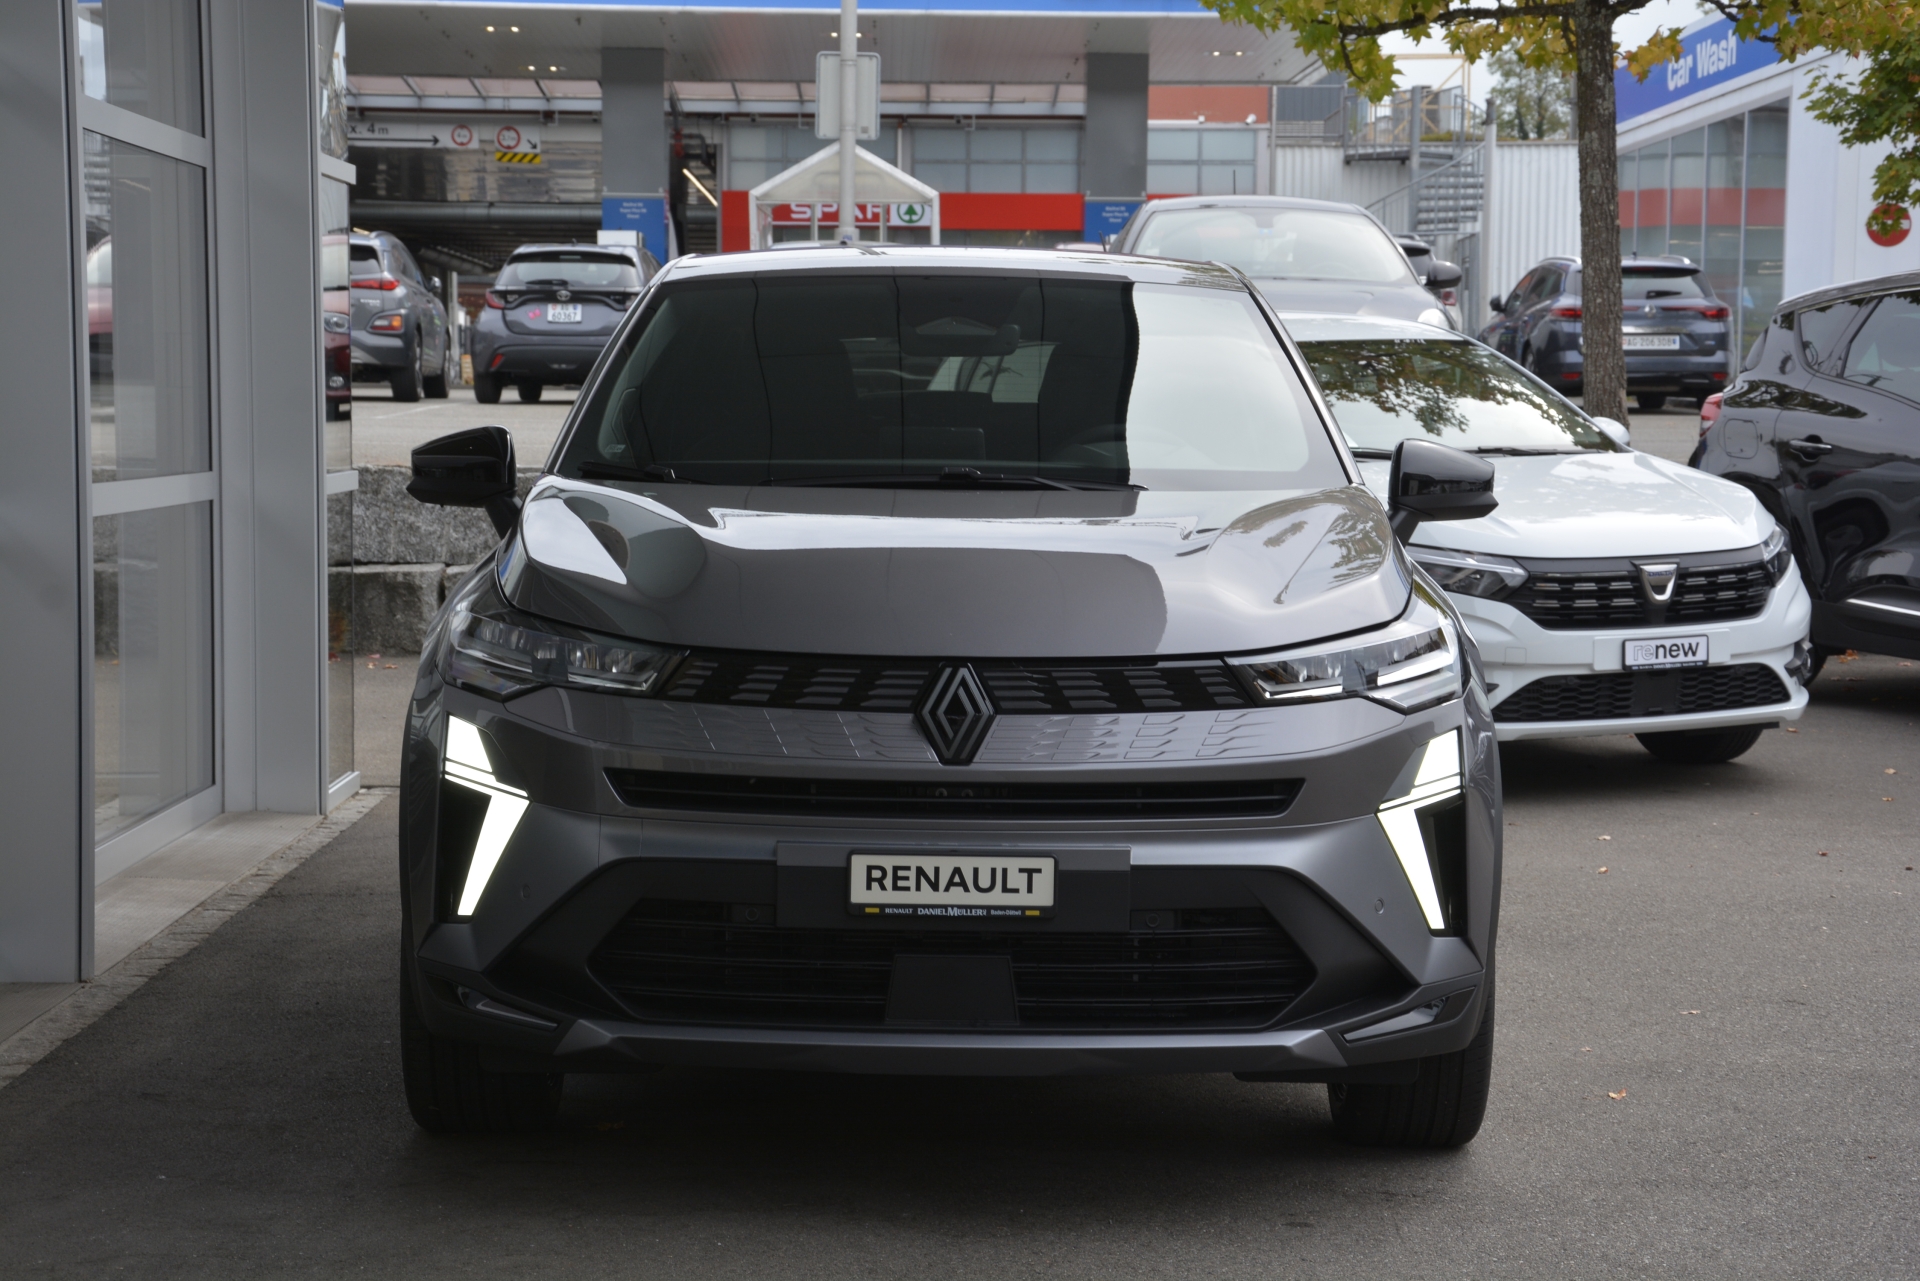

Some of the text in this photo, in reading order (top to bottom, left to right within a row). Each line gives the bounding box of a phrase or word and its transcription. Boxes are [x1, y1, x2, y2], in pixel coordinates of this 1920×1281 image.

[1667, 29, 1737, 91] Car Wash
[552, 311, 577, 321] 60367
[1633, 642, 1700, 661] renew
[865, 864, 1043, 894] RENAULT
